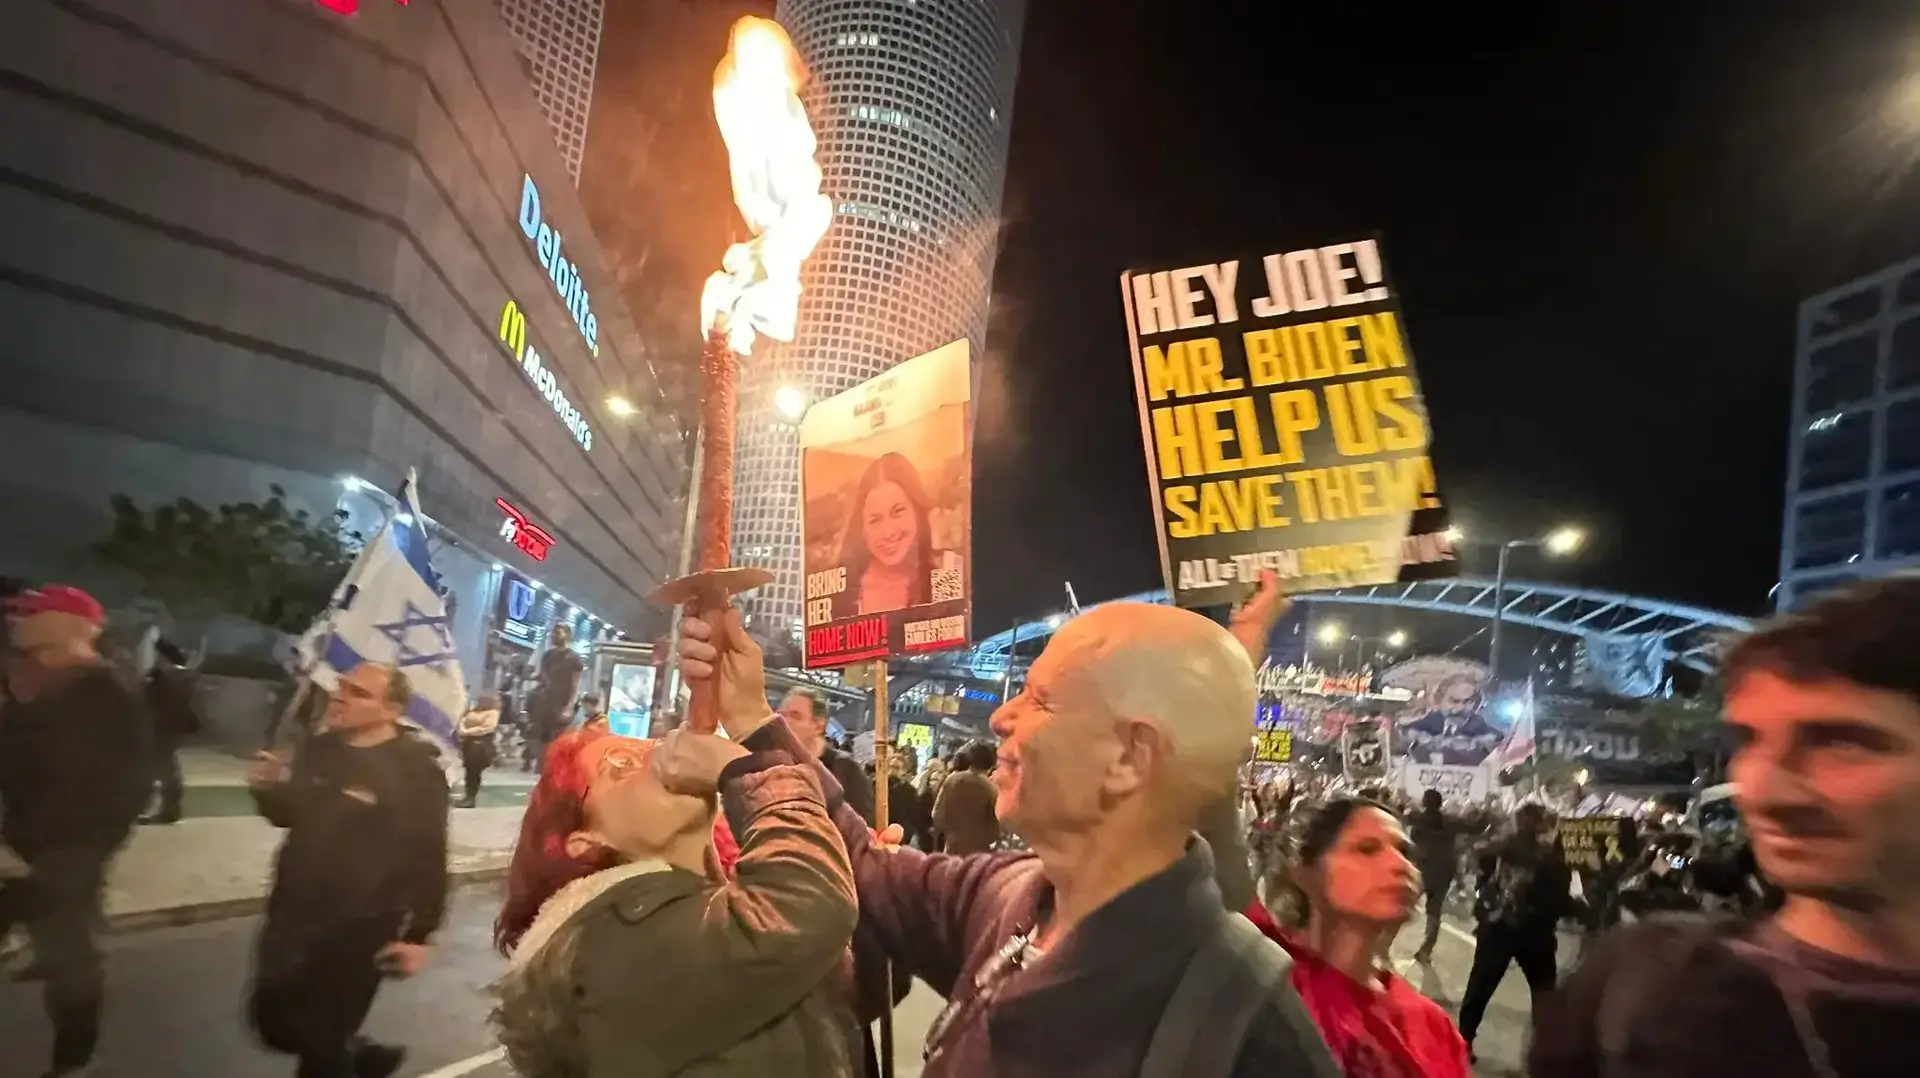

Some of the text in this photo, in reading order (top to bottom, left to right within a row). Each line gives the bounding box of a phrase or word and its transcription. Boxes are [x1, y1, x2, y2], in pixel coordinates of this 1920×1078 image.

[519, 173, 599, 358] Deloitte.
[1132, 239, 1388, 335] HEY JOE!
[523, 345, 593, 452] McDonald's
[1143, 311, 1407, 401] MR. BIDEN
[1152, 375, 1428, 479] HELP US
[1165, 456, 1442, 539] SAVE THEM!
[807, 566, 847, 599] BRING
[808, 598, 833, 626] HER
[1178, 558, 1229, 589] ALL
[808, 622, 845, 655] HOME
[846, 614, 888, 651] NOW!
